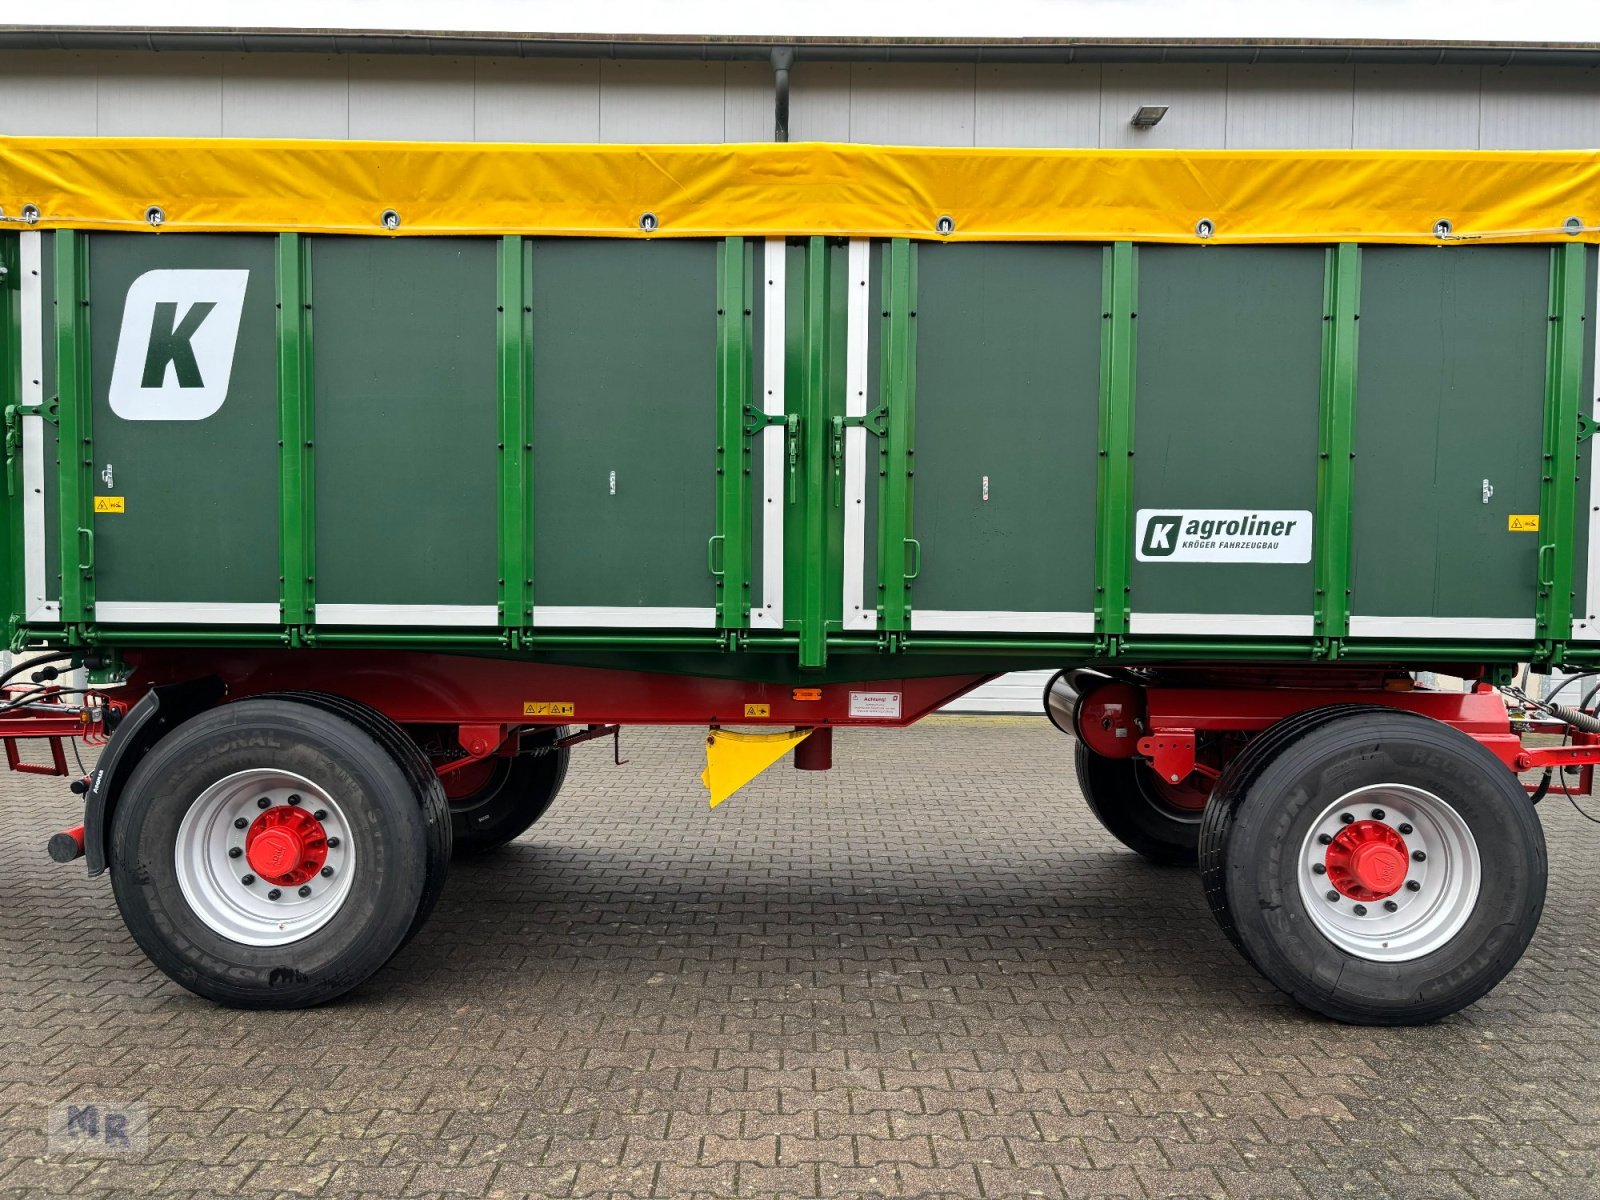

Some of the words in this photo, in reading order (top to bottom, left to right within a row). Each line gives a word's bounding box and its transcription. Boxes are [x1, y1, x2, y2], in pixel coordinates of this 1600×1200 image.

[140, 302, 218, 388] K
[1150, 523, 1175, 549] K
[1185, 514, 1297, 540] agroliner
[1182, 540, 1216, 549] KRÖGER
[1218, 541, 1279, 550] FAHRZEUGBAU
